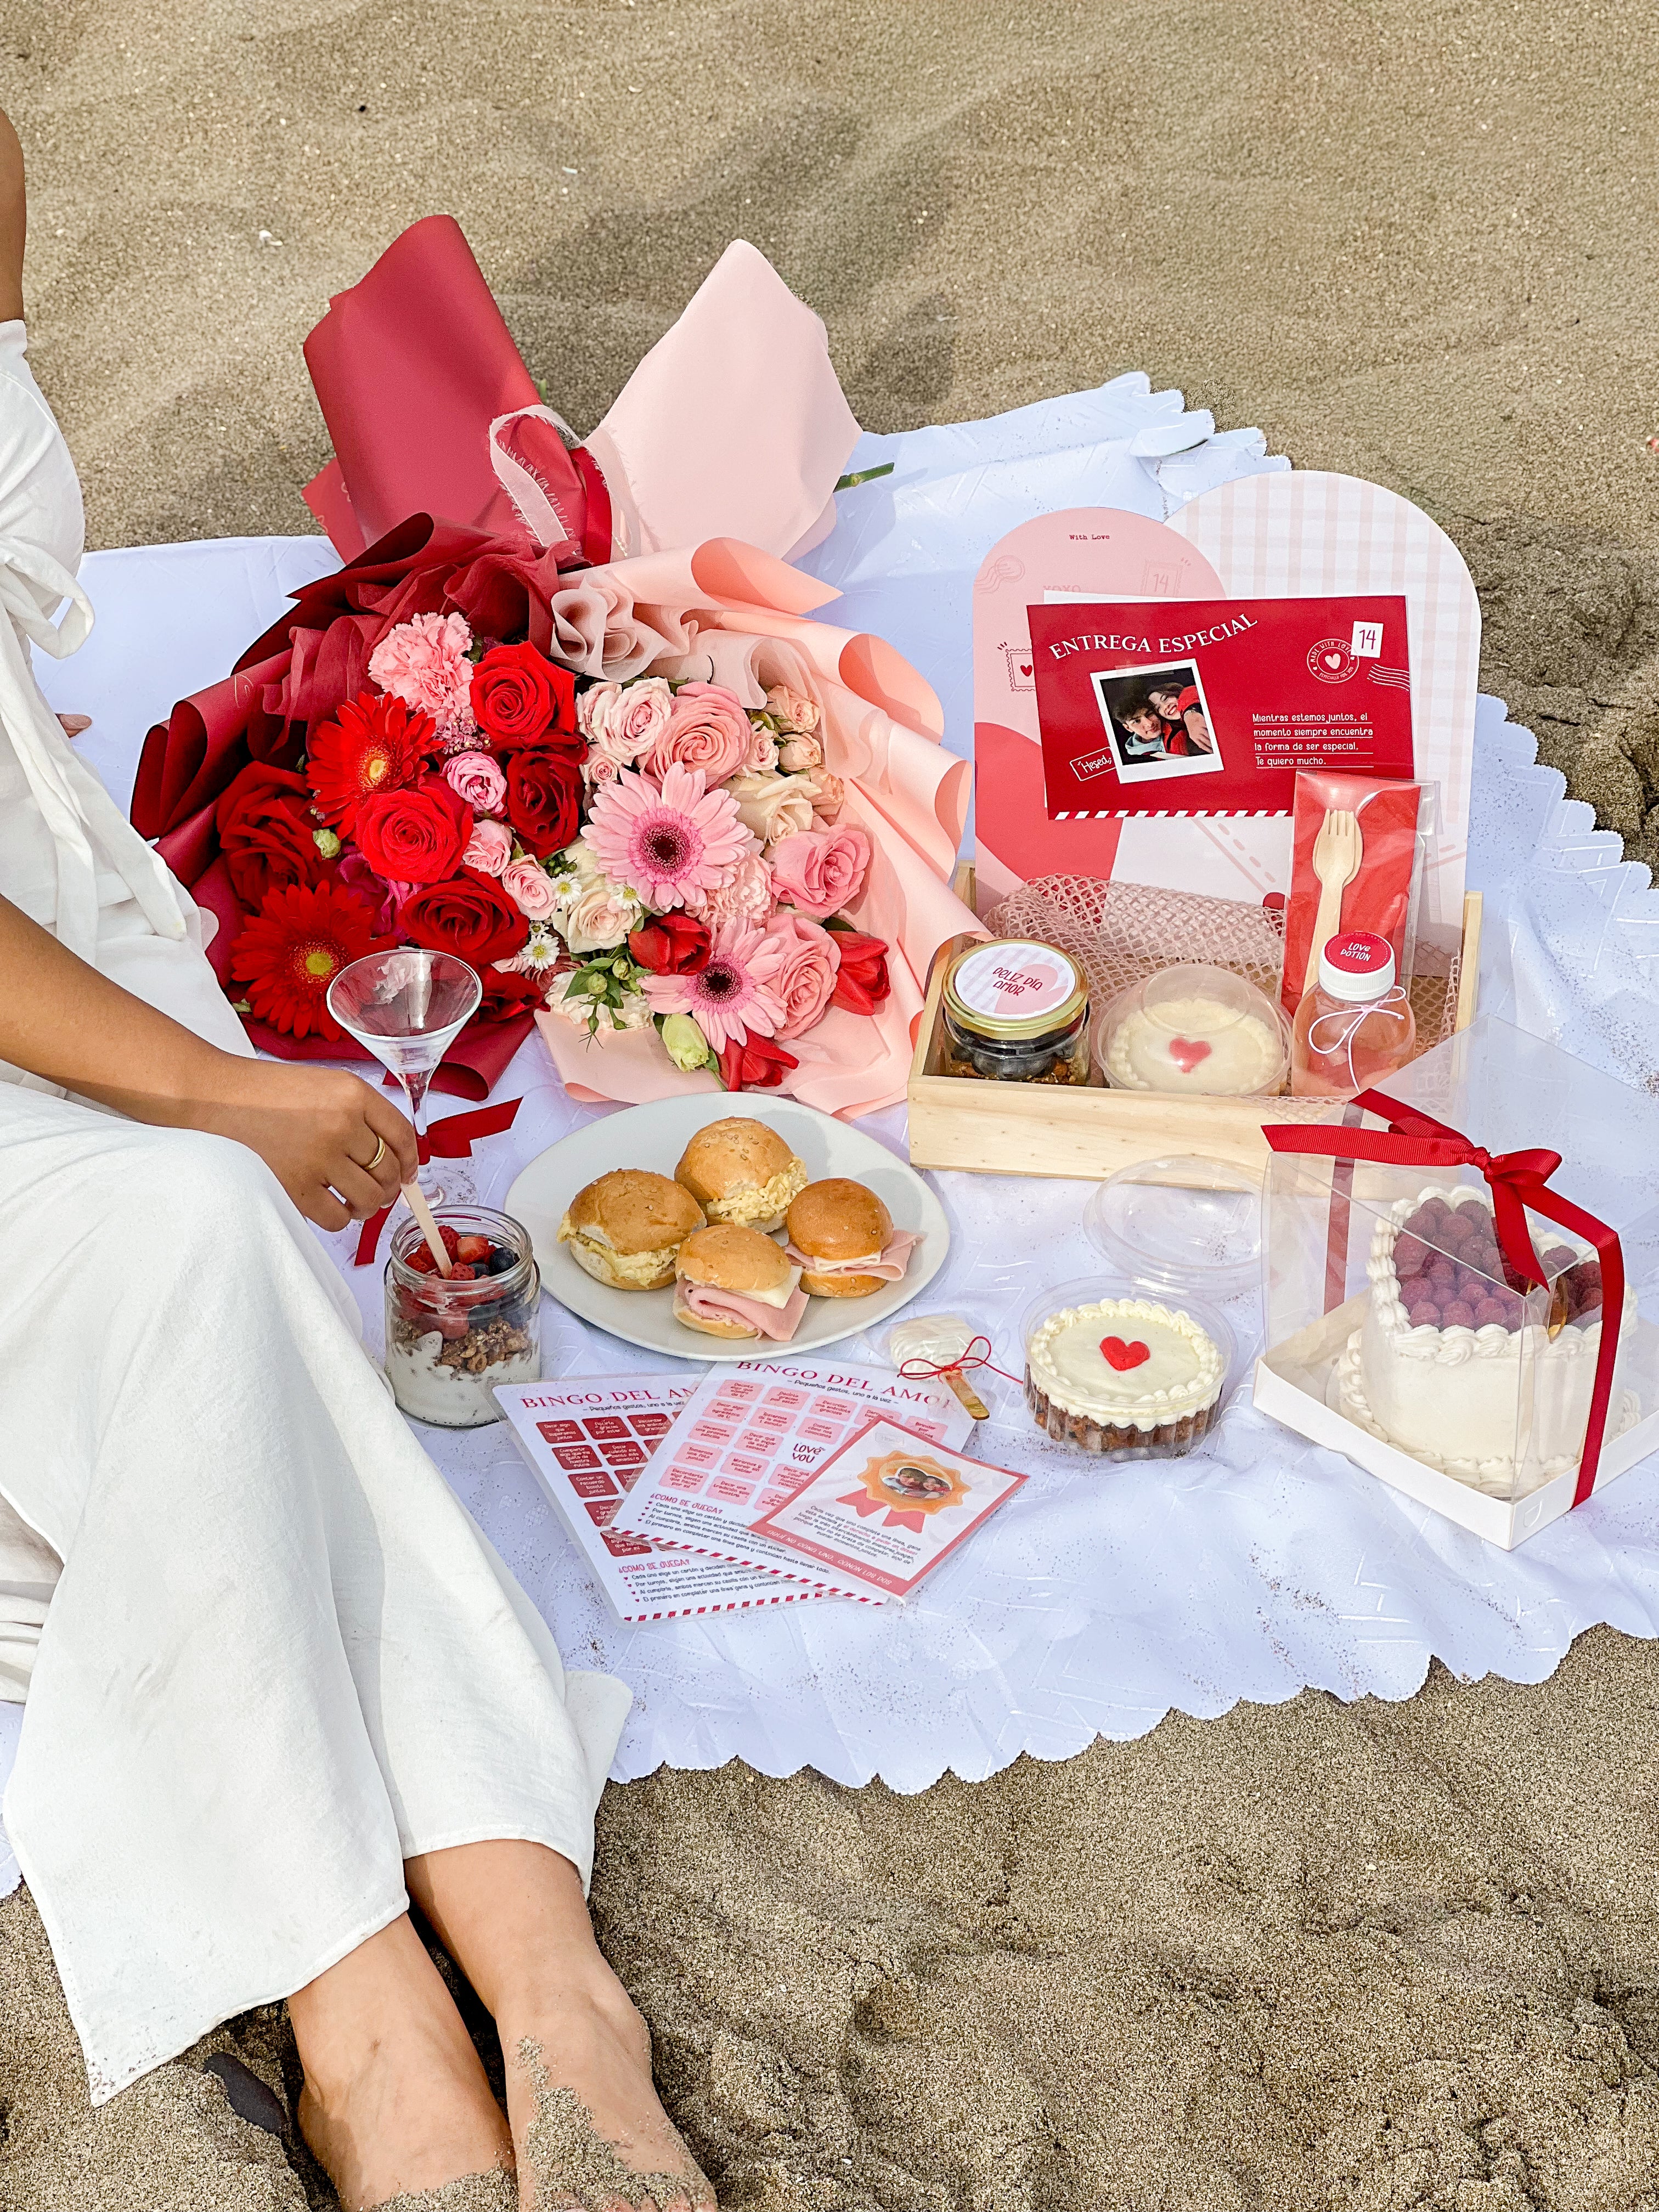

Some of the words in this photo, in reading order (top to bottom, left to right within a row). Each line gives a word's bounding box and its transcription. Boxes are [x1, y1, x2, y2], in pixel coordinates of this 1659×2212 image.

[1048, 635, 1152, 660] ENTREGA
[1158, 613, 1258, 653] ESPECIAL
[1359, 629, 1376, 650] 14
[1310, 648, 1319, 663] MADE
[1319, 641, 1334, 649] WITH
[1252, 713, 1288, 723] Mientras
[1360, 713, 1368, 721] el
[1294, 729, 1328, 738] siempre
[1330, 727, 1373, 736] encuentra
[1255, 743, 1262, 751] la
[1265, 742, 1290, 751] forma
[1293, 742, 1303, 751] de
[1256, 756, 1264, 765] Te
[1267, 757, 1294, 766] quiero
[1297, 755, 1327, 765] mucho.
[1340, 949, 1372, 962] POTION
[993, 980, 1025, 996] AMOR
[736, 1361, 817, 1380] BINGO
[825, 1373, 874, 1392] DEL
[794, 1379, 825, 1389] Pequeños
[521, 1393, 601, 1407] BINGO
[610, 1390, 659, 1401] DEL
[792, 1452, 815, 1463] YOU
[682, 1529, 710, 1538] completar
[862, 1570, 876, 1578] LOS
[876, 1576, 892, 1585] DOS
